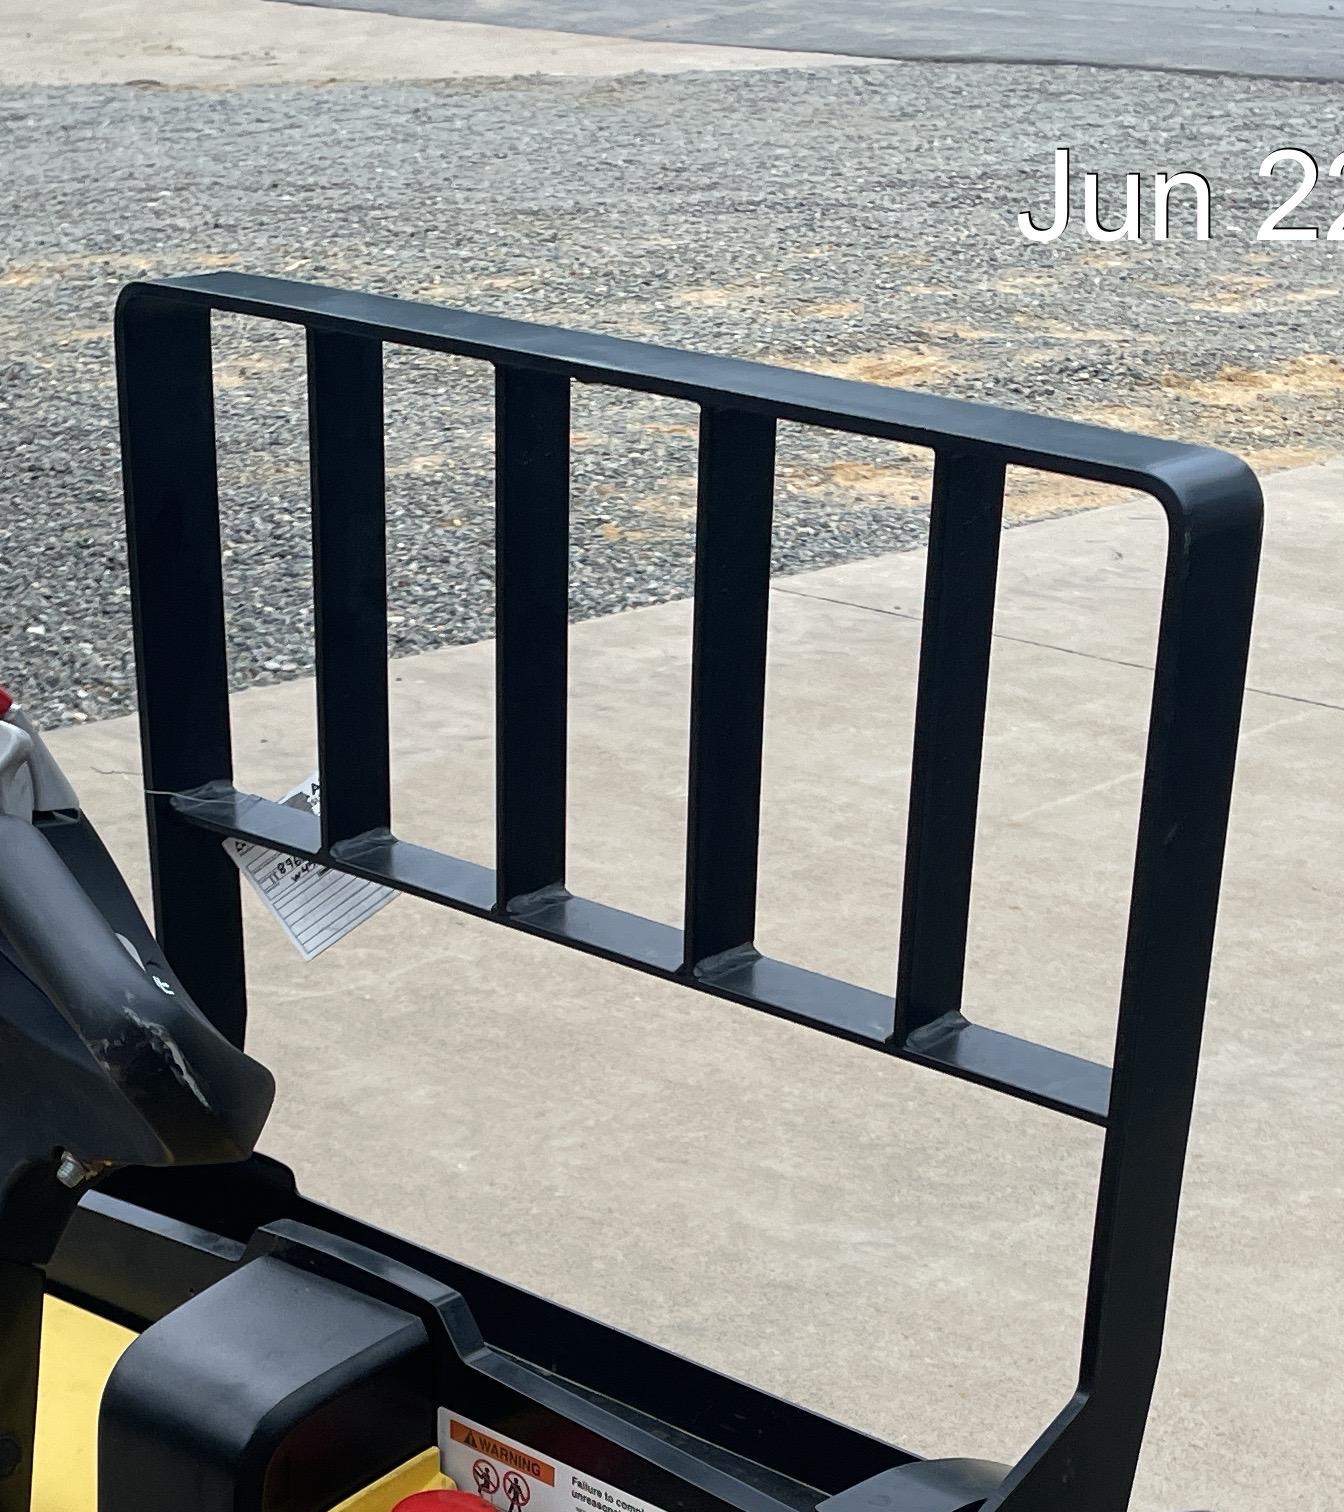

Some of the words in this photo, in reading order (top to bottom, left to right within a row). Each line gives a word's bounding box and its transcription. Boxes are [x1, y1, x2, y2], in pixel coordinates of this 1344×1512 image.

[478, 1435, 541, 1477] WARNING
[571, 1476, 603, 1498] Failure
[605, 1491, 614, 1504] to
